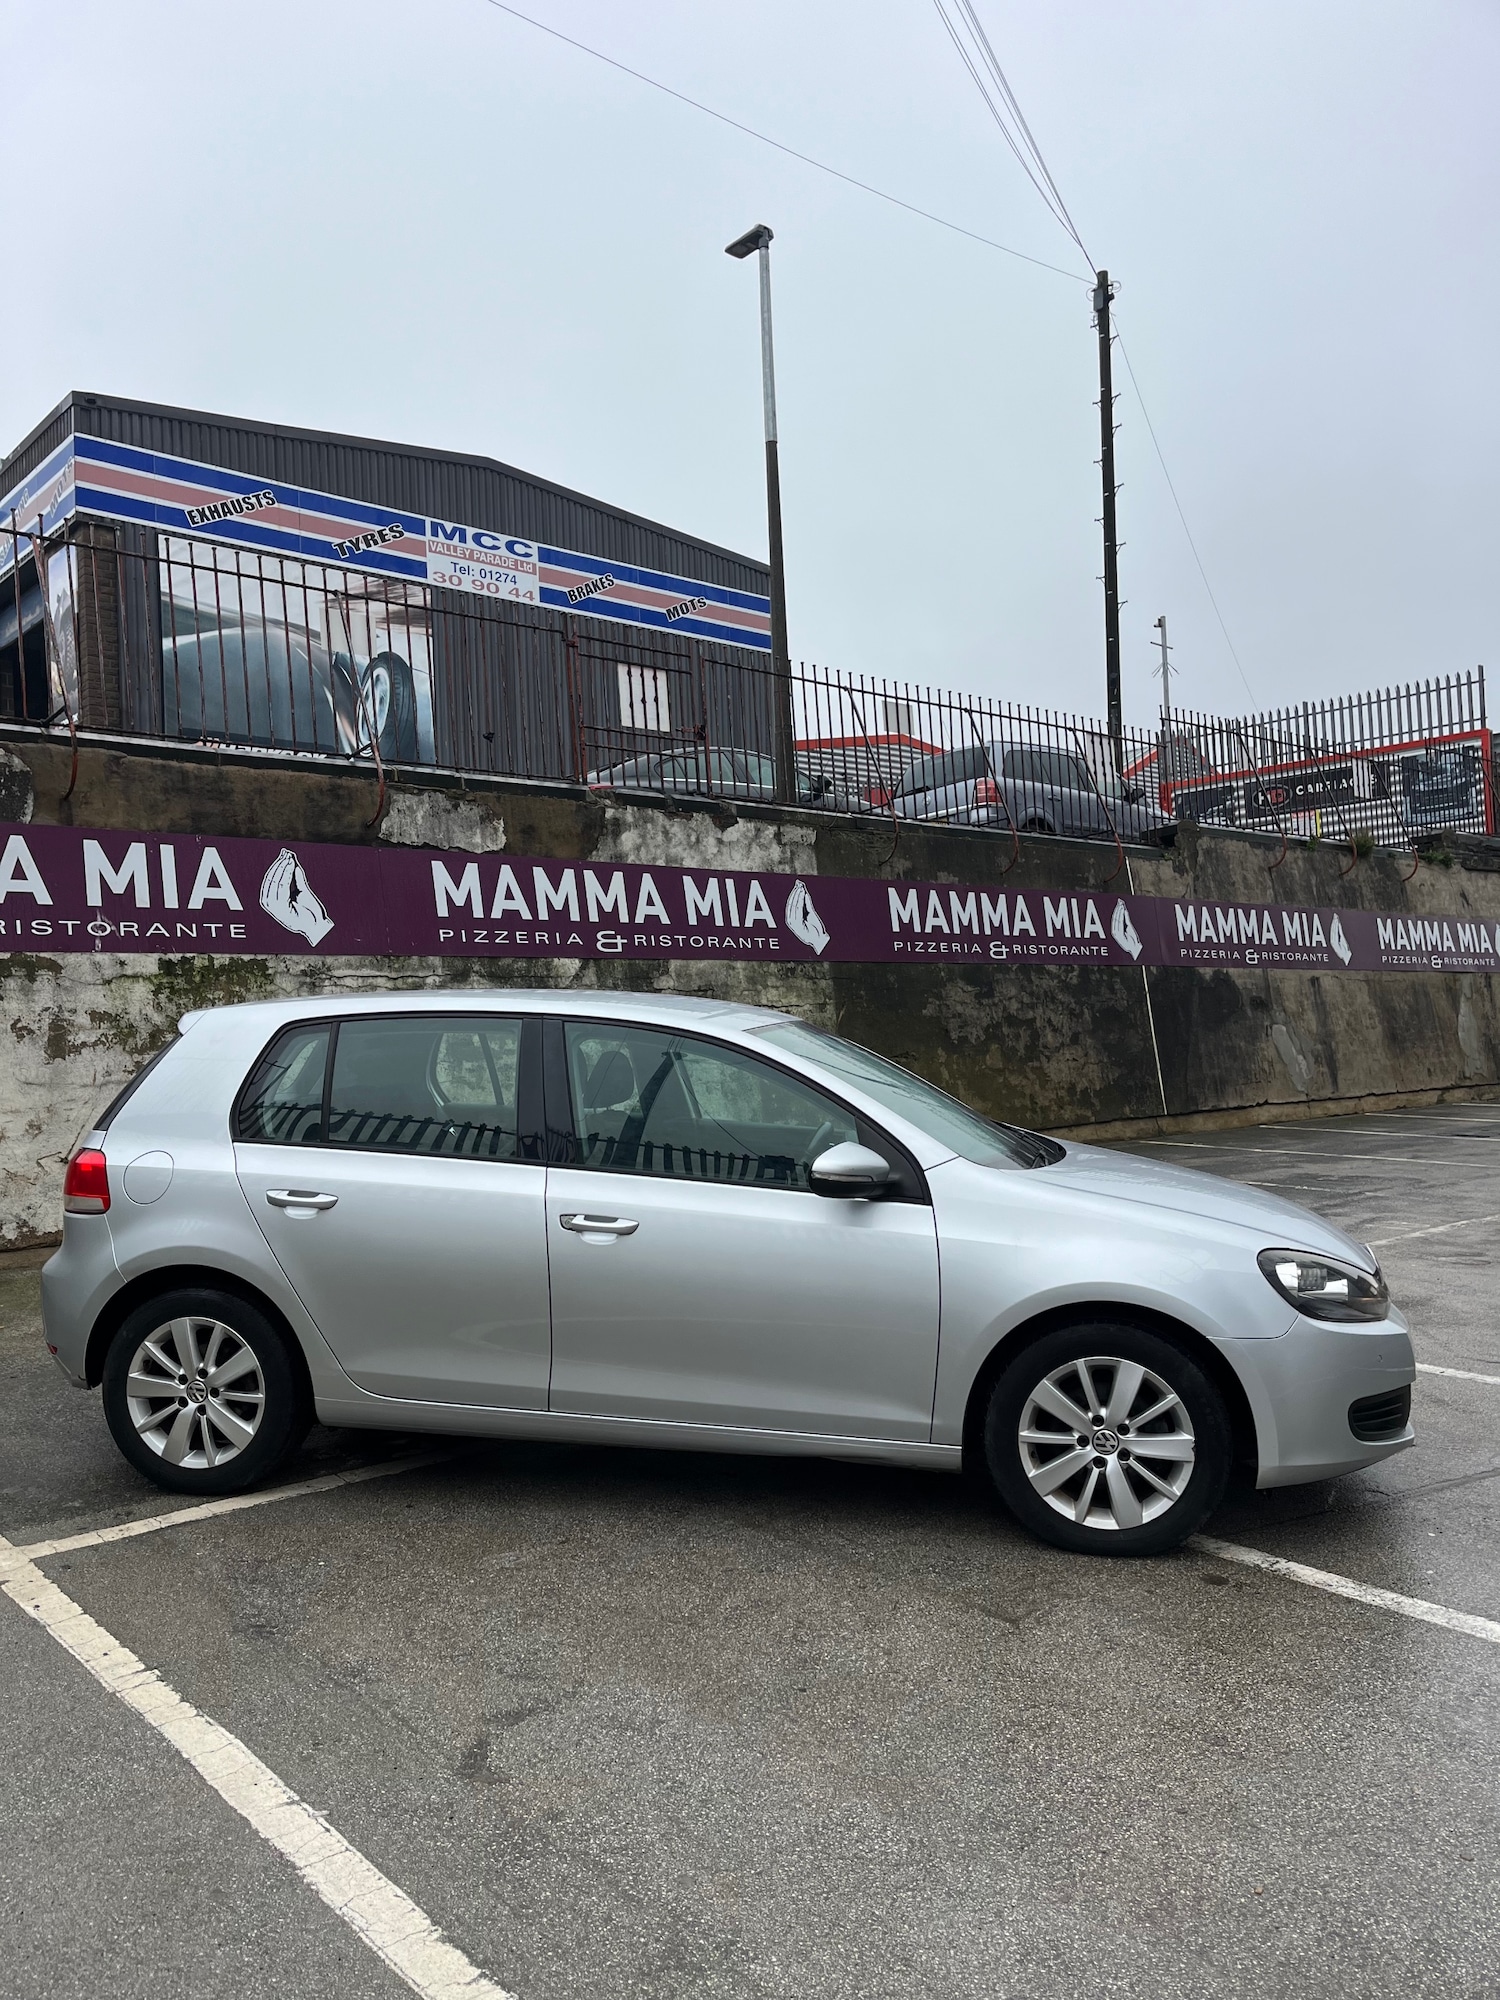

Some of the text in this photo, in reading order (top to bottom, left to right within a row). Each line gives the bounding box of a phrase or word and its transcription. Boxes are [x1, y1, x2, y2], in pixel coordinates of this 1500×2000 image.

[185, 490, 277, 526] EXHAUSTS
[333, 523, 406, 558] TYRES
[430, 520, 534, 558] MCC
[429, 540, 533, 573] VALLEY PARADE Ltd
[450, 561, 518, 586] Tel: 01274
[432, 571, 536, 602] 30 90 44
[567, 574, 615, 603] BRAKES
[82, 838, 244, 911] MIA
[431, 860, 777, 929] MAMMA MIA
[887, 886, 1107, 939] MAMMA MIA
[1174, 903, 1328, 948] MAMMA MIA
[438, 928, 780, 953] PIZZERIA & RISTORANTE
[893, 940, 1109, 959] PIZZERIA & RISTORANTE
[1376, 917, 1494, 954] MAMMA MIA
[1180, 948, 1330, 965] PIZZERIA & RISTORANTE
[1381, 954, 1496, 969] PIZZERIA & RISTORANTE
